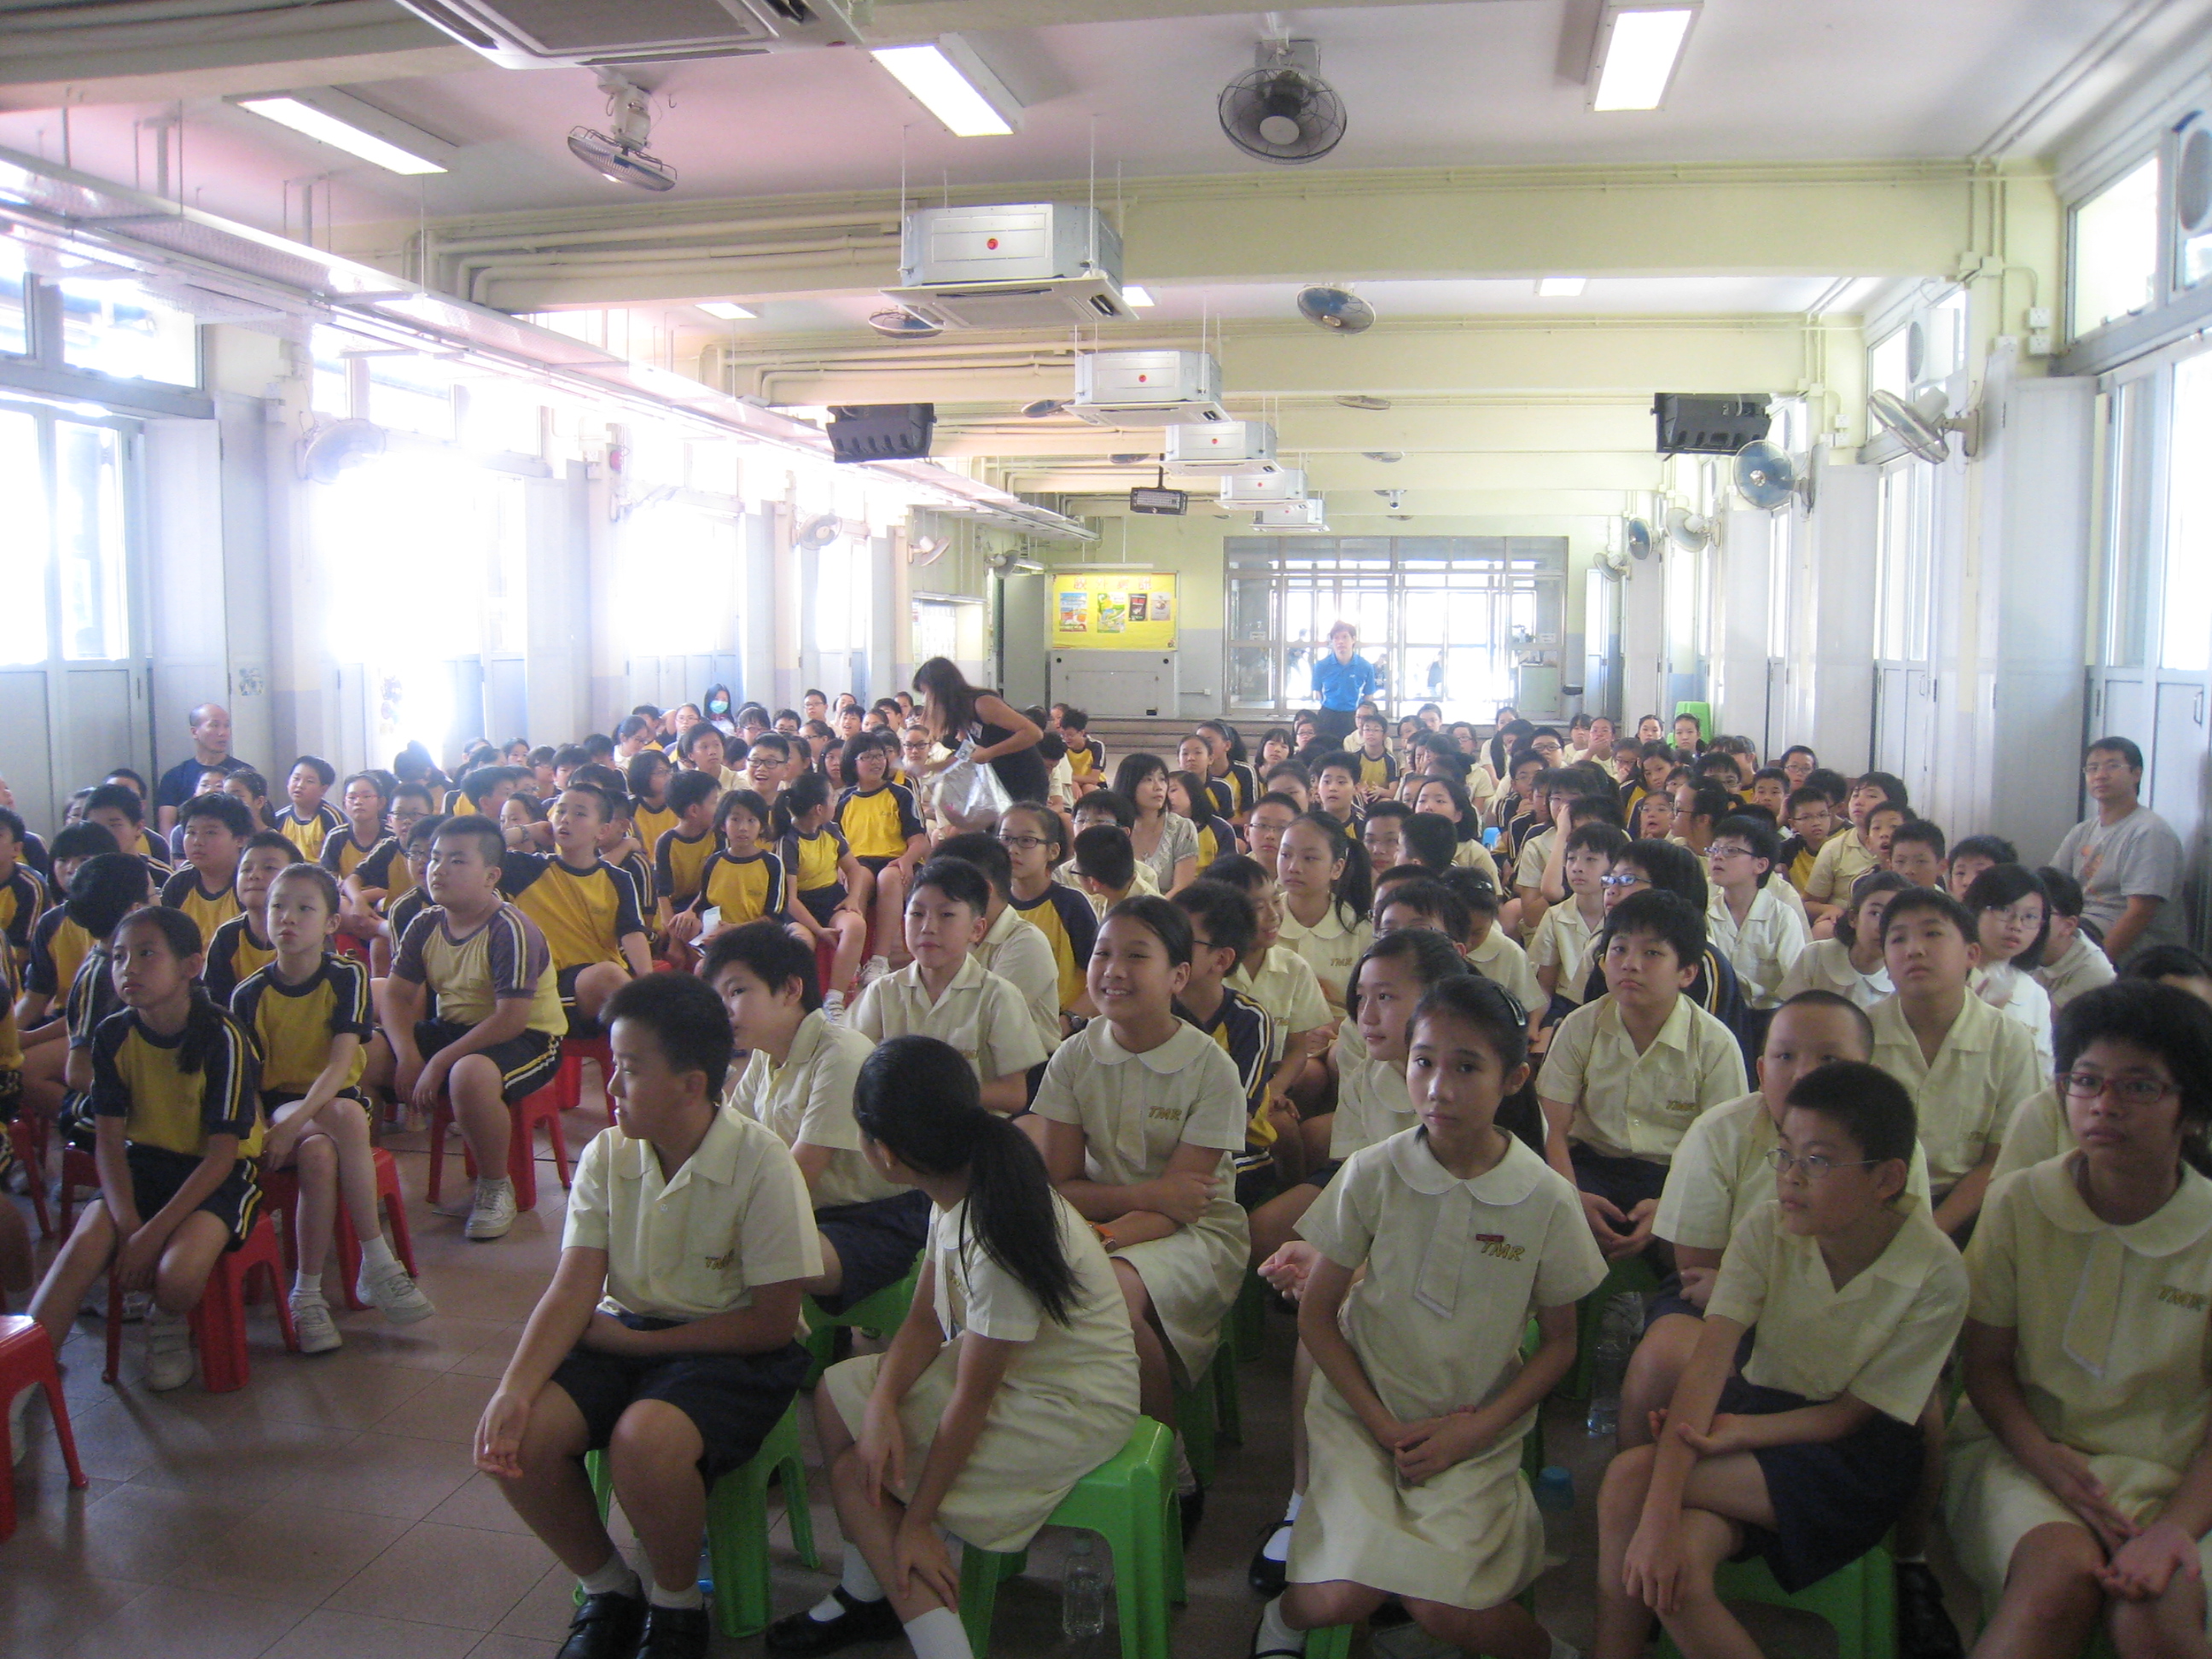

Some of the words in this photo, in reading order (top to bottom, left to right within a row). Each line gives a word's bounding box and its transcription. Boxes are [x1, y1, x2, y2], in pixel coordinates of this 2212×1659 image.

[1148, 1106, 1183, 1121] TMR
[1481, 1242, 1526, 1261] TMR
[2158, 1286, 2208, 1312] TMR
